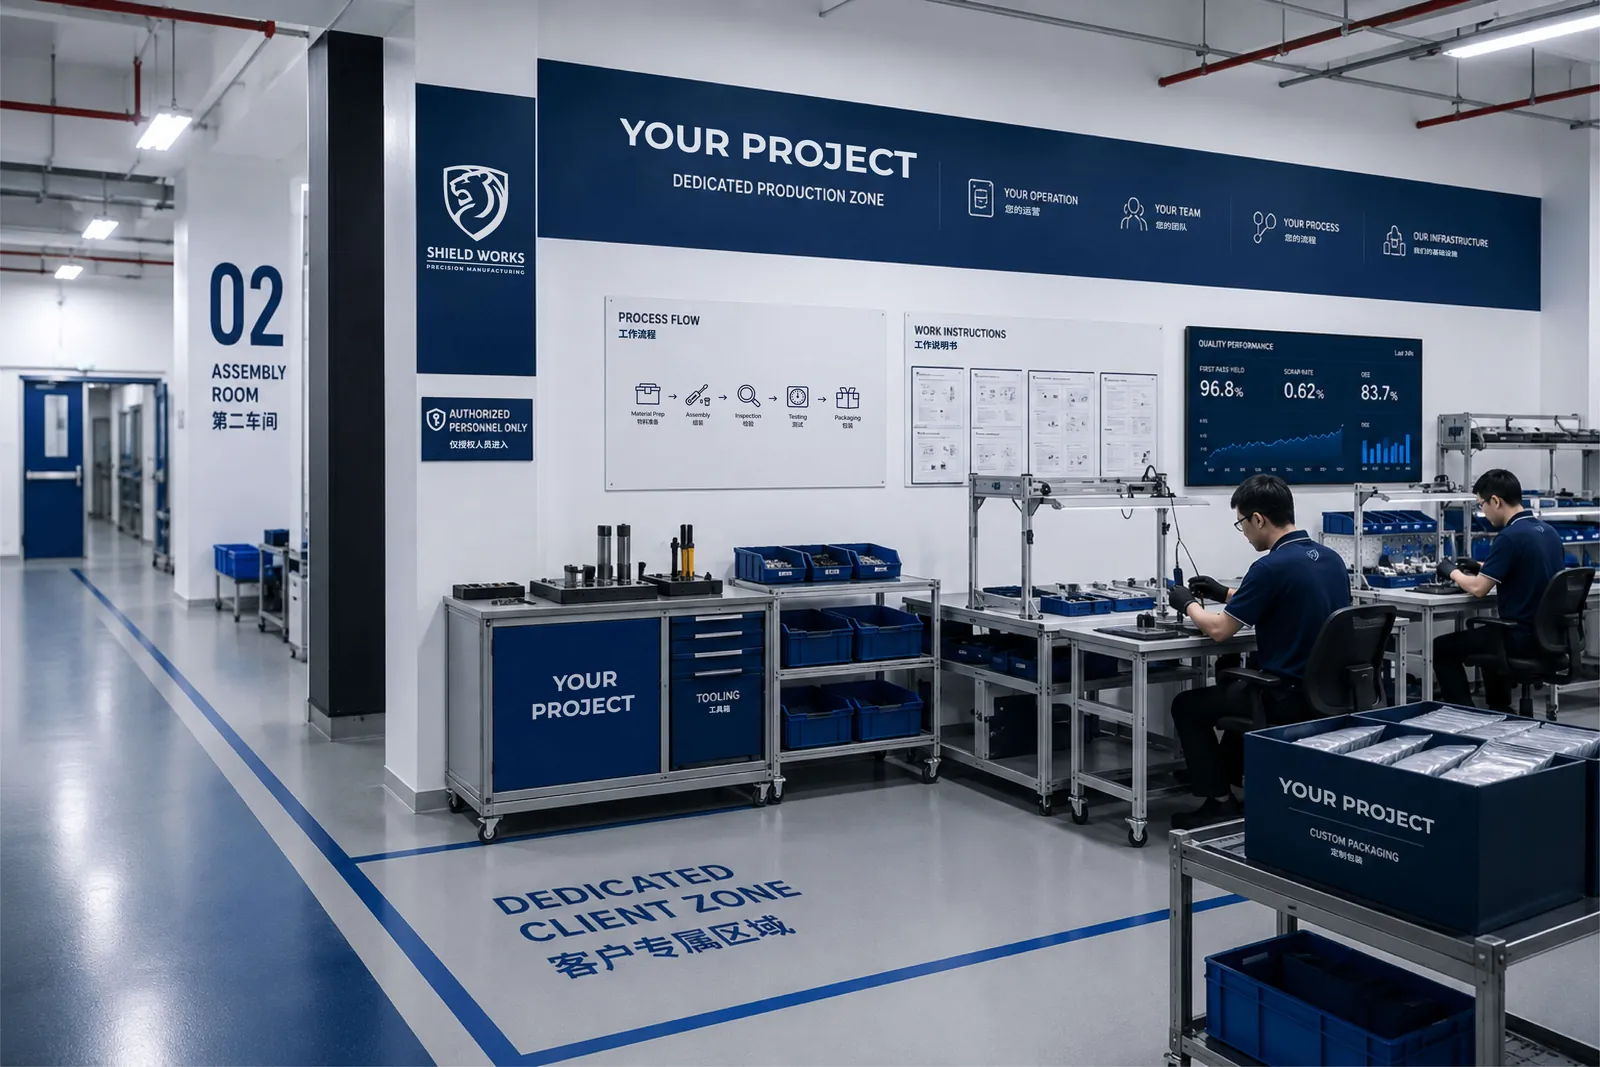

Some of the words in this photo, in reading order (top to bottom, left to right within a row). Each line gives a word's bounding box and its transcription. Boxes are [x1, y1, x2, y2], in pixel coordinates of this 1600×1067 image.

[620, 118, 729, 157] YOUR
[742, 132, 918, 179] PROJECT
[673, 173, 754, 194] DEDICATED
[757, 182, 846, 203] PRODUCTION
[849, 190, 885, 207] ZONE
[1004, 188, 1028, 201] YOUR
[1030, 191, 1079, 206] OPERATION
[1005, 205, 1041, 217] 您的运营
[1155, 203, 1177, 216] YOUR
[1179, 206, 1201, 218] TEAM
[1155, 221, 1188, 232] 您的团队
[1283, 217, 1304, 230] YOUR
[1306, 220, 1340, 233] PROCESS
[1284, 233, 1317, 245] 您的流程
[1413, 231, 1428, 241] OUR
[1430, 233, 1489, 248] INFRASTRUCTURE
[427, 246, 474, 261] SHIELD
[477, 250, 525, 264] WORKS
[426, 264, 464, 272] PRECISION
[467, 267, 525, 275] MANUFACTURING
[210, 262, 283, 346] 02
[618, 312, 668, 324] PROCESS
[671, 314, 700, 326] FLOW
[618, 329, 656, 340] 工作流程
[914, 325, 942, 336] WORK
[943, 327, 1007, 339] INSTRUCTIONS
[914, 340, 958, 350] 工作说明书
[1198, 340, 1226, 348] QUALITY
[1227, 341, 1274, 350] PERFORMANCE
[212, 363, 287, 380] ASSEMBLY
[212, 387, 258, 403] ROOM
[1200, 380, 1244, 397] 96.8%
[1284, 382, 1325, 399] 0.62%
[1361, 384, 1398, 400] 83.7%
[212, 411, 278, 431] 第二车间
[450, 409, 510, 420] AUTHORIZED
[450, 422, 502, 433] PERSONNEL
[504, 423, 528, 433] ONLY
[449, 440, 508, 450] 仅授权人员进入
[552, 670, 617, 692] YOUR
[696, 690, 740, 703] TOOLING
[531, 694, 635, 720] PROJECT
[708, 705, 731, 714] 工具箱
[1278, 776, 1337, 809] YOUR
[1342, 795, 1435, 834] PROJECT
[1310, 827, 1346, 847] CUSTOM
[1347, 839, 1399, 862] PACKAGING
[1330, 847, 1363, 865] 定制包装
[493, 864, 734, 915] DEDICATED
[519, 900, 676, 942] CLIENT
[682, 880, 803, 914] ZONE
[547, 915, 796, 980] 客户专属区域
